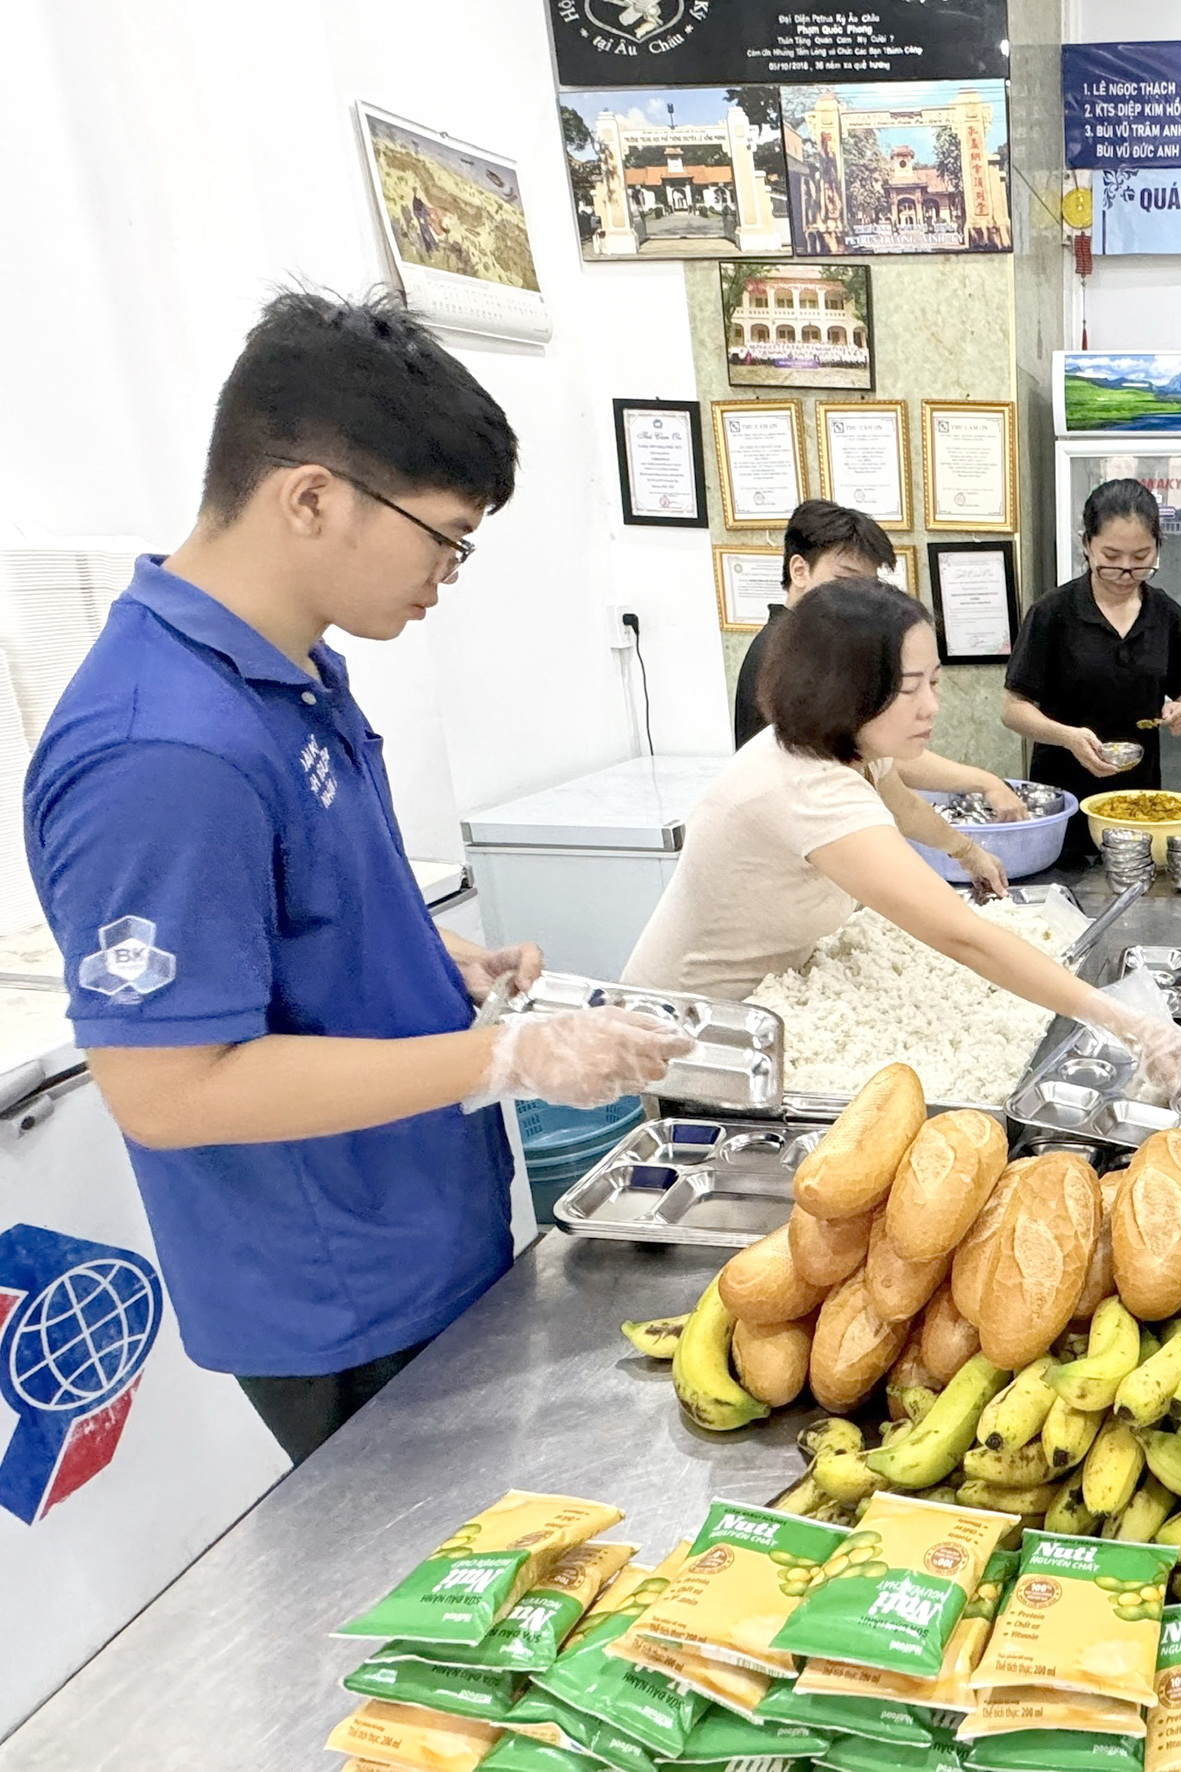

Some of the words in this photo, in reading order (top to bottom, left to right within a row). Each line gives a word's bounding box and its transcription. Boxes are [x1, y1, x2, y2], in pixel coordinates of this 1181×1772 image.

[847, 25, 872, 35] Phong
[593, 36, 614, 51] tại
[614, 39, 637, 56] Âu
[649, 33, 685, 53] Châu
[1093, 80, 1106, 95] LÊ
[1109, 83, 1138, 99] NGỌC
[1140, 82, 1175, 98] THẠCH
[1085, 104, 1092, 117] 2.
[1095, 103, 1115, 117] KTS
[1117, 103, 1141, 119] DIỆP
[1145, 103, 1163, 116] KIM
[1085, 125, 1093, 137] 3.
[1096, 123, 1113, 137] BÙI
[1116, 123, 1129, 137] VŨ
[1131, 122, 1160, 137] TRÂM
[1096, 144, 1113, 157] BÙI
[1116, 143, 1129, 158] VŨ
[1132, 143, 1154, 158] ĐỨC
[1157, 144, 1179, 157] ANH
[114, 948, 146, 963] BK
[716, 1513, 781, 1538] Nuti
[1032, 1541, 1098, 1563] Nuti
[1030, 1556, 1070, 1569] NGUYÊN
[1071, 1560, 1100, 1572] CHẤT
[432, 1568, 504, 1594] Nuti
[869, 1591, 941, 1624] Nuti
[1018, 1610, 1045, 1620] Protein
[1034, 1665, 1046, 1675] 200
[622, 1672, 647, 1693] NÀNH
[647, 1683, 666, 1701] ĐẬU
[880, 1710, 914, 1725] Nutifood
[1021, 1707, 1033, 1717] 200
